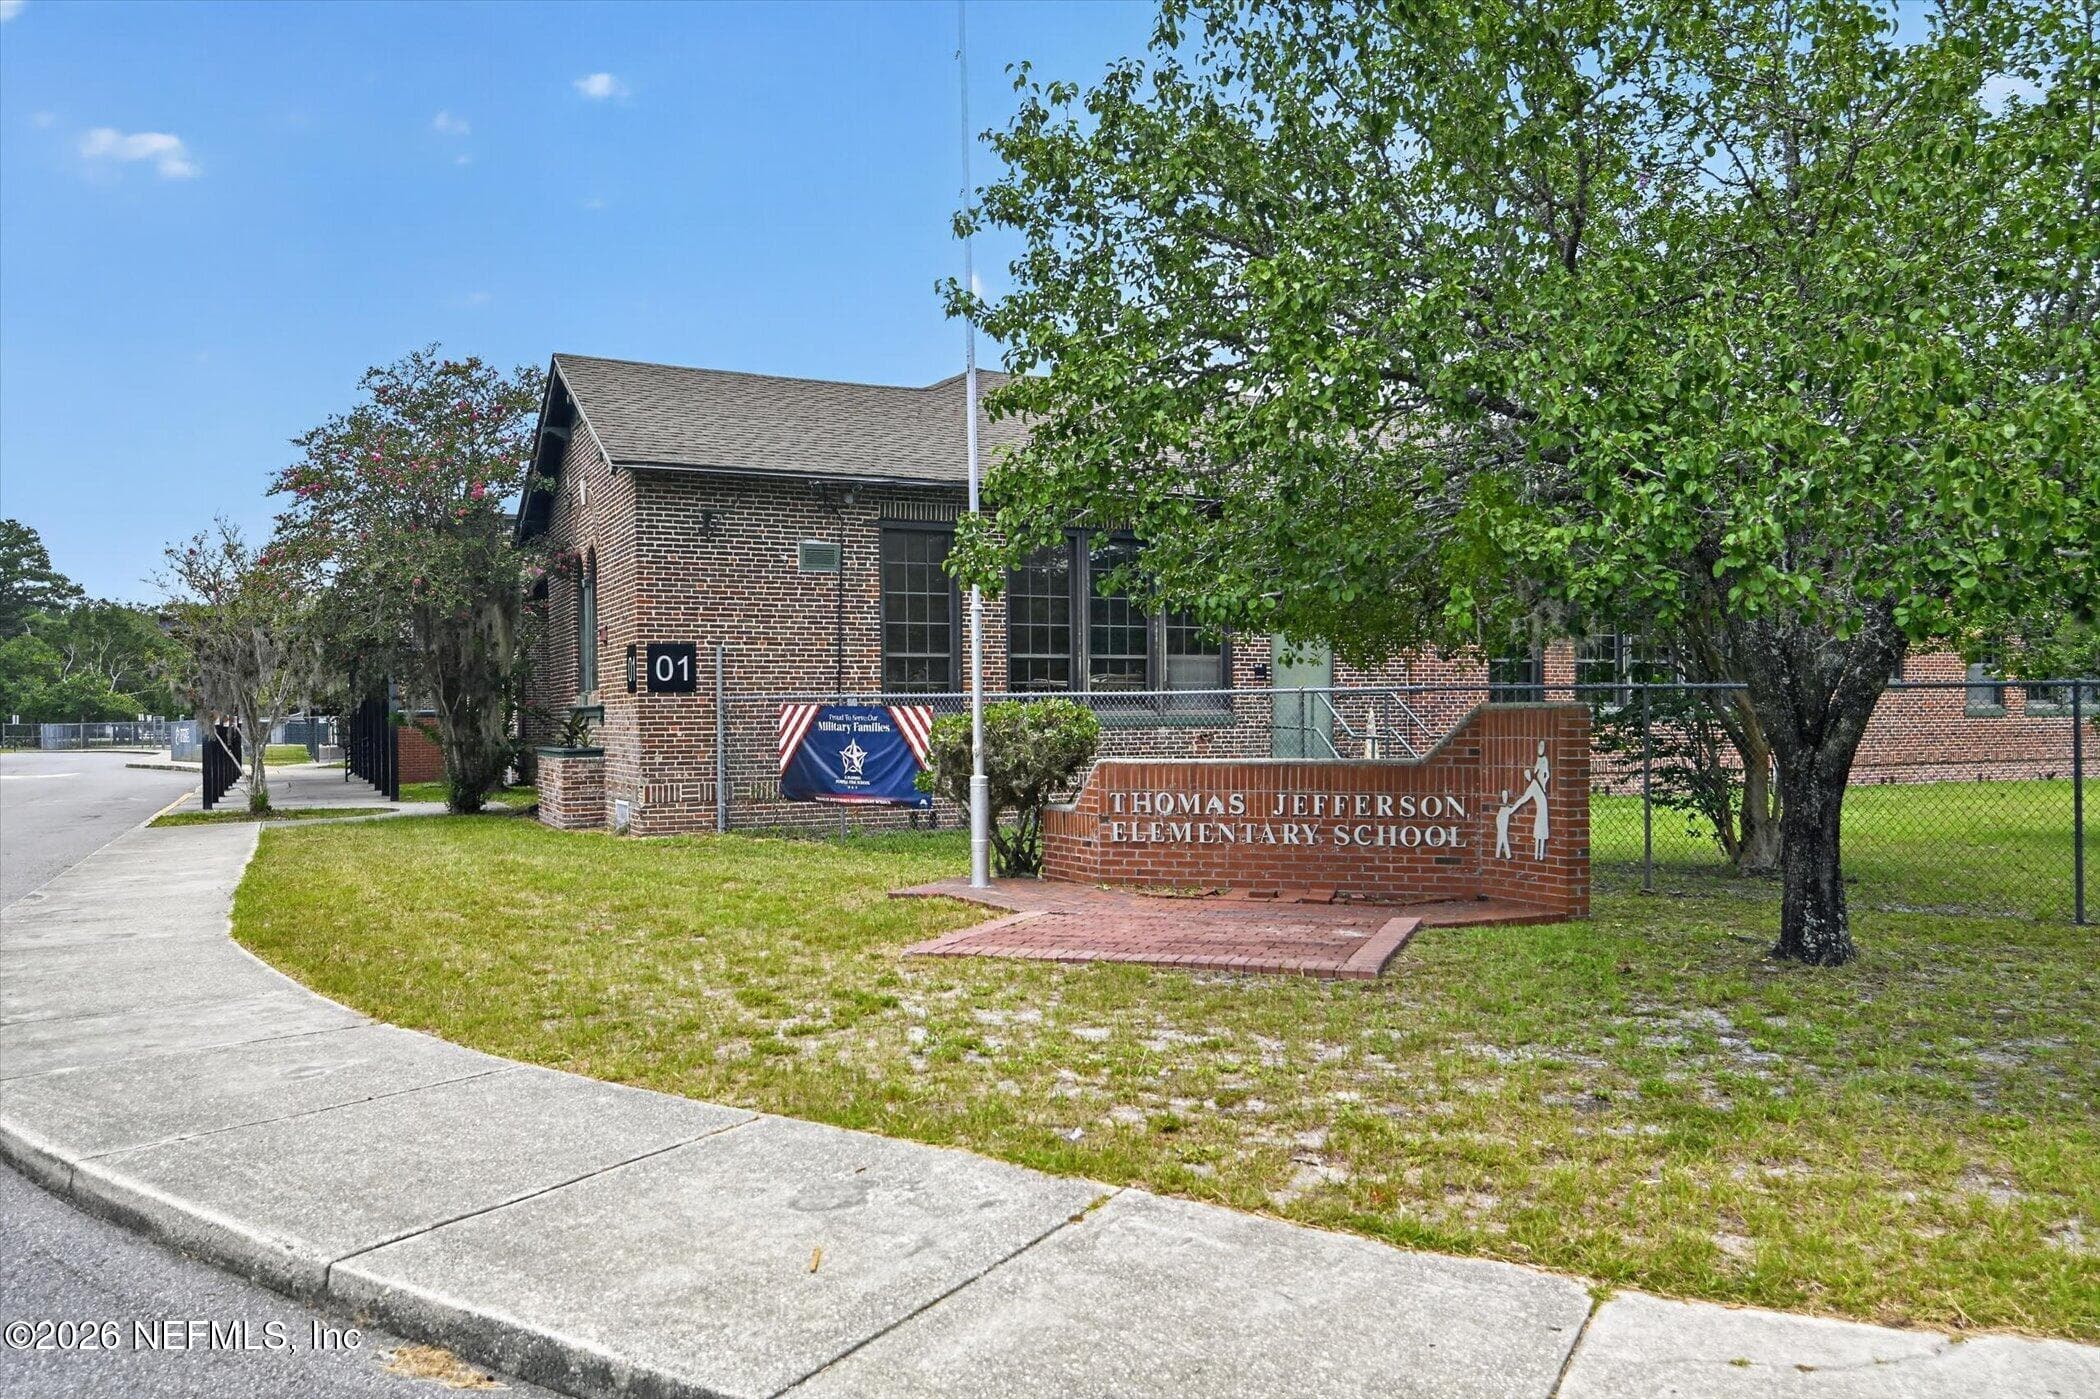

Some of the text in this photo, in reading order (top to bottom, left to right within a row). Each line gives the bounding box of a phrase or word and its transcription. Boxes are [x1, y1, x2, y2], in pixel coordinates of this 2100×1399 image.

[628, 656, 635, 682] 01
[656, 655, 688, 681] 01
[818, 721, 890, 734] Military Families
[1110, 792, 1466, 817] THOMAS JEFFERSON
[1112, 821, 1467, 848] ELEMENTARY SCHOOL
